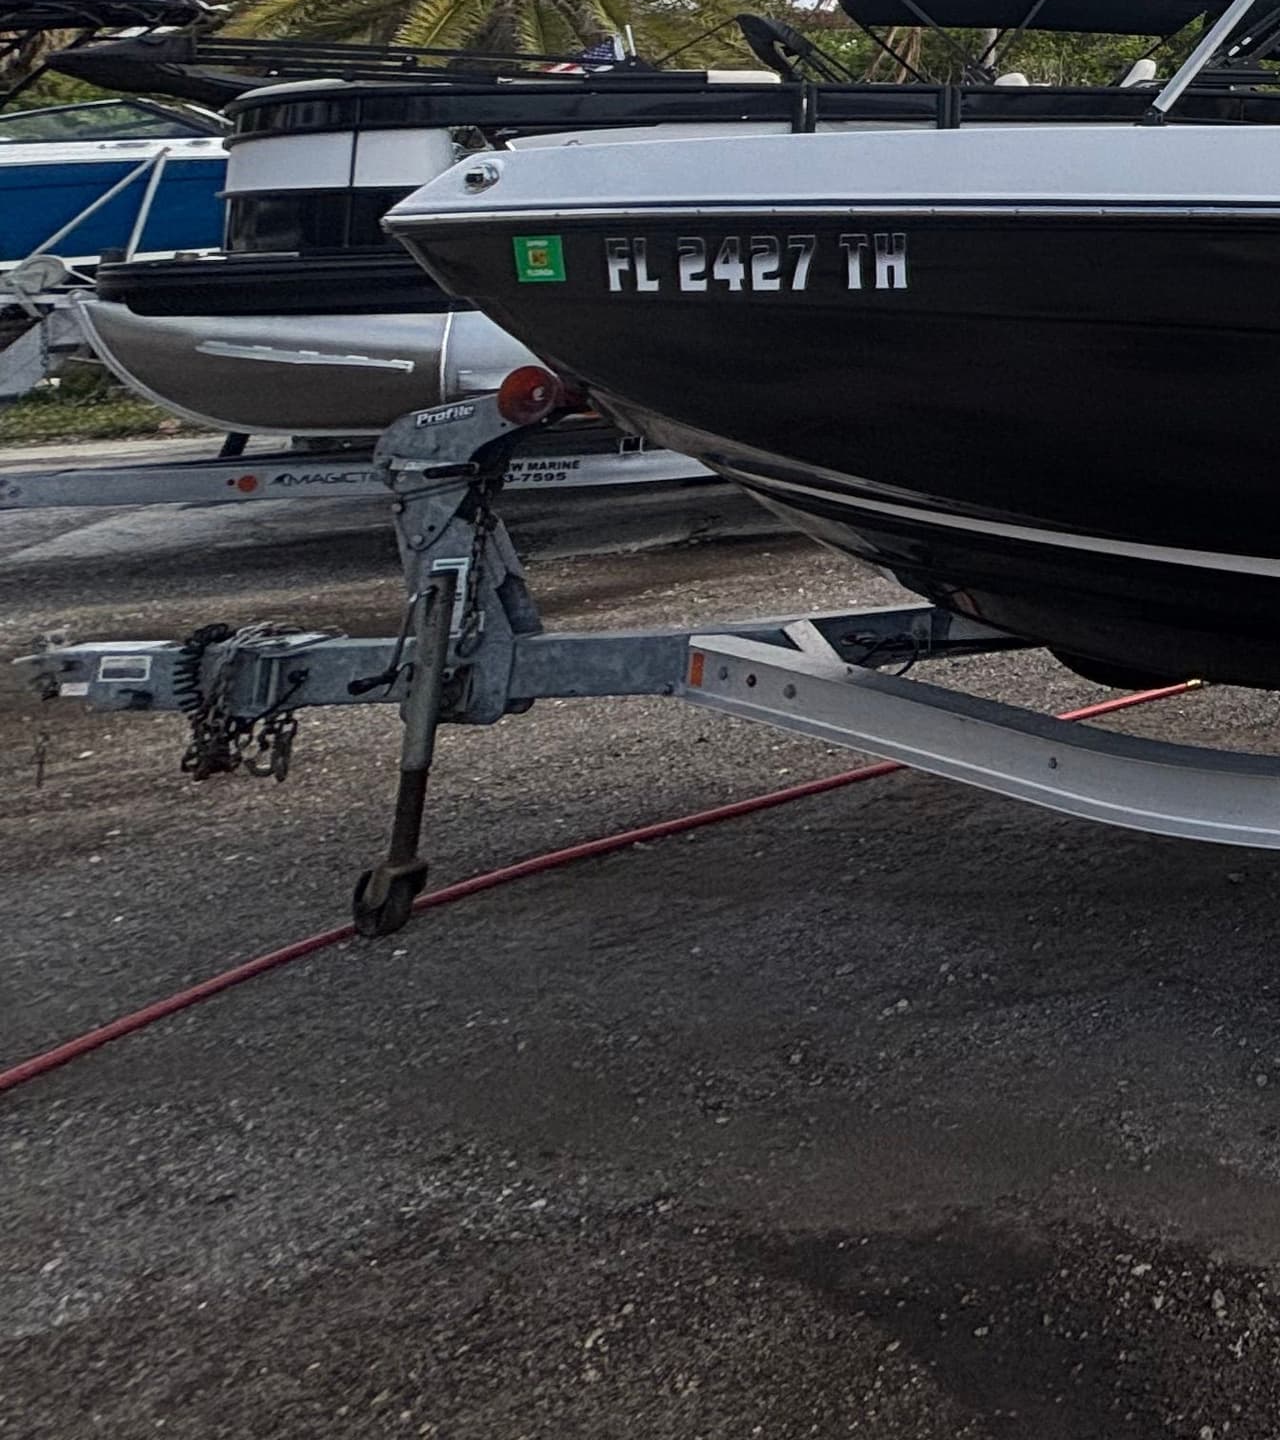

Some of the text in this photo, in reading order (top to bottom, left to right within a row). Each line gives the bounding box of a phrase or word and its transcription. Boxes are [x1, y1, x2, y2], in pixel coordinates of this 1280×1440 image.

[604, 233, 908, 292] FL 2427 TH
[417, 405, 475, 427] Profile
[527, 460, 580, 471] MARINE
